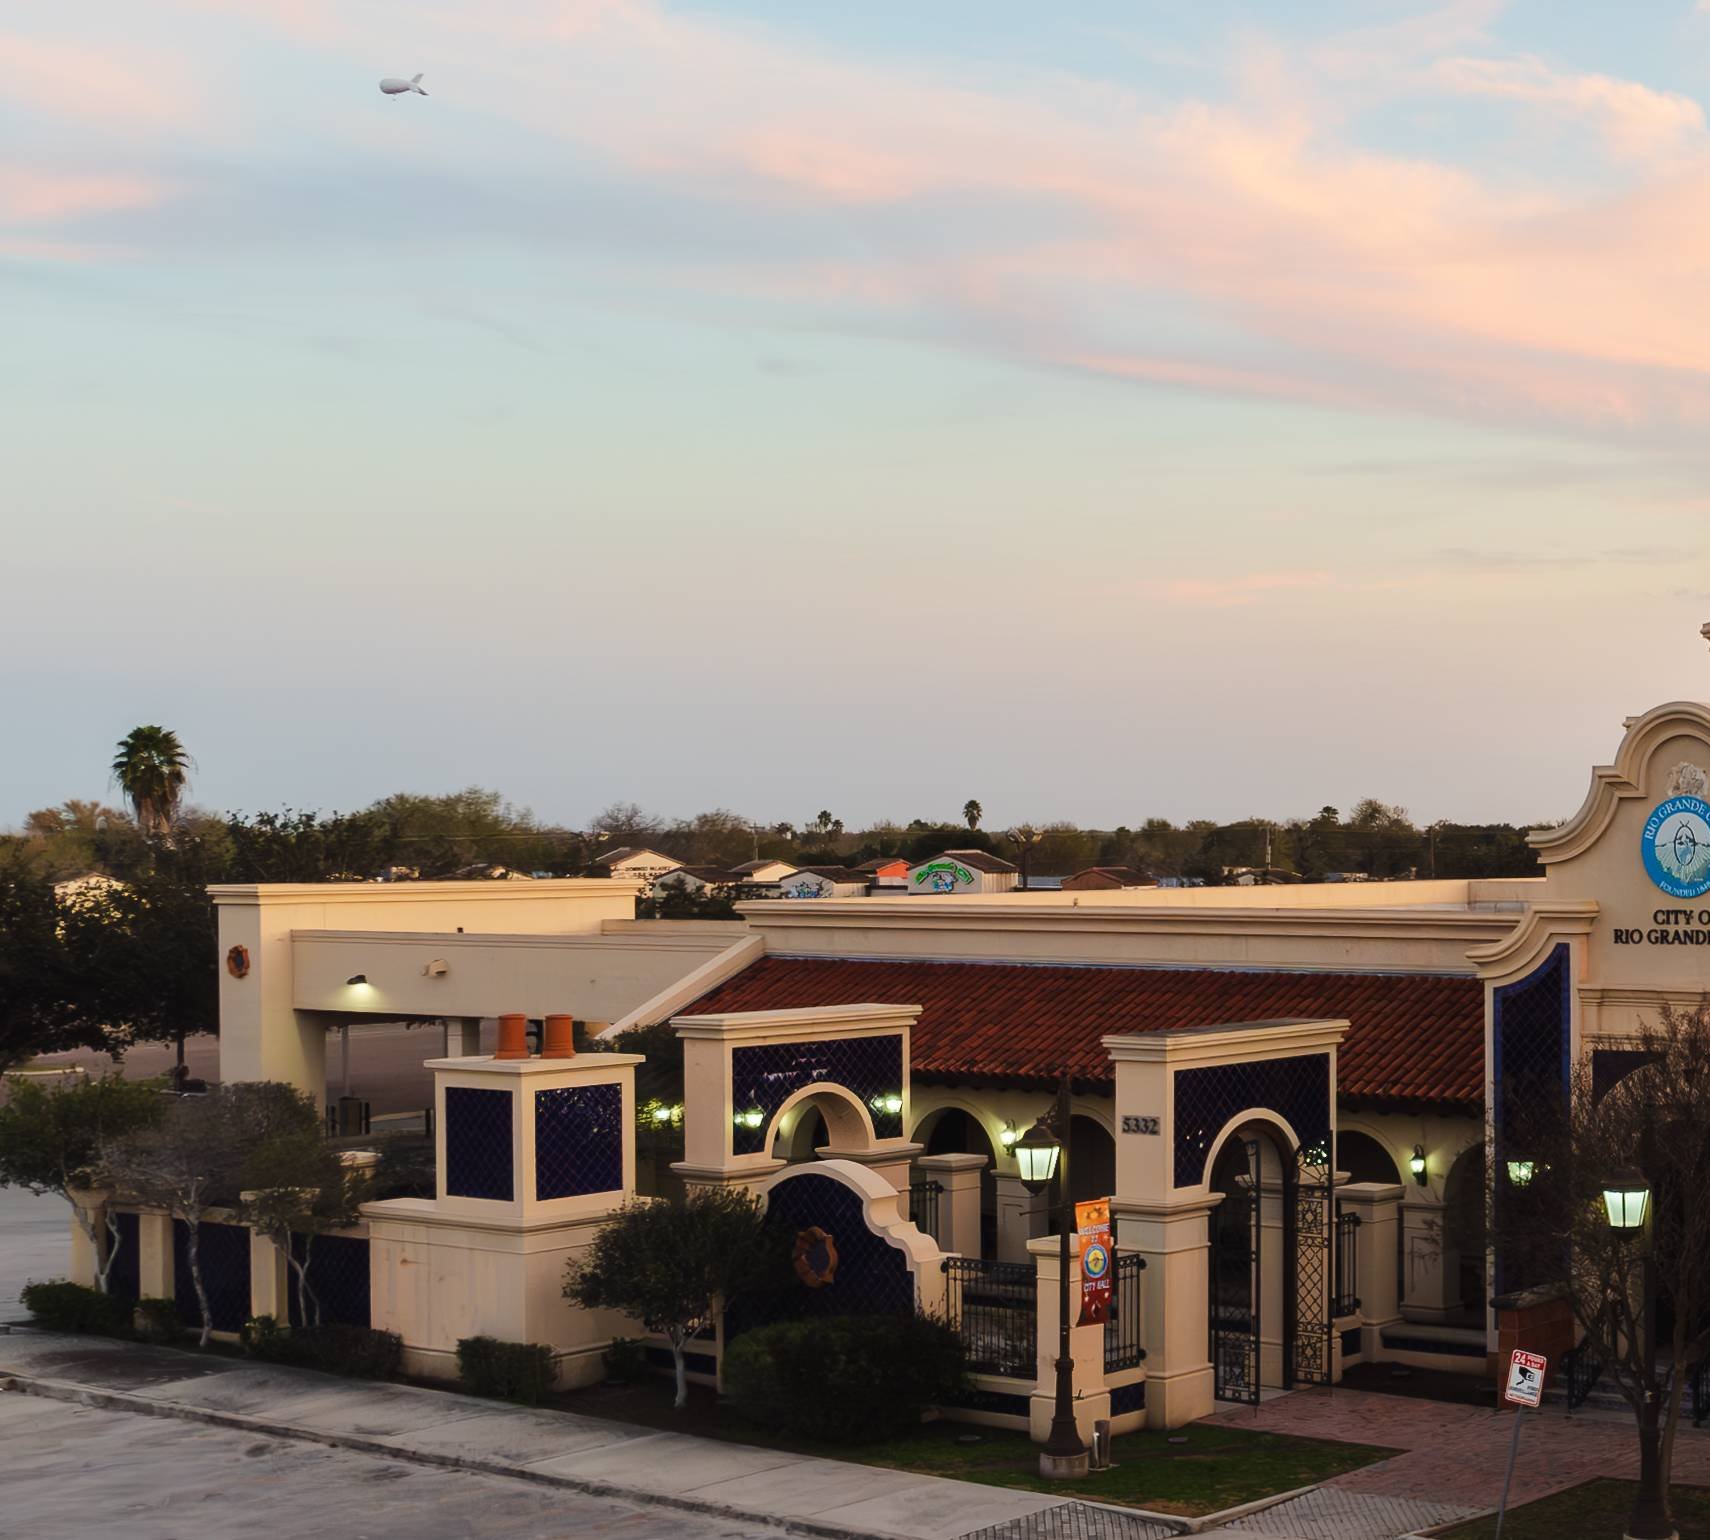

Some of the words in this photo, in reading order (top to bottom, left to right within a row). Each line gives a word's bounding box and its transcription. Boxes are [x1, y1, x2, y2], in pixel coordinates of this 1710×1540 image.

[1644, 814, 1660, 840] RIO
[1659, 799, 1705, 820] GRANDE
[1653, 909, 1694, 926] CITY
[1613, 928, 1643, 944] RIO
[1122, 1117, 1159, 1133] 5332
[1080, 1223, 1110, 1235] WELCOME
[1084, 1283, 1096, 1292] CITY
[1097, 1279, 1110, 1290] HALL
[1515, 1352, 1526, 1364] 24
